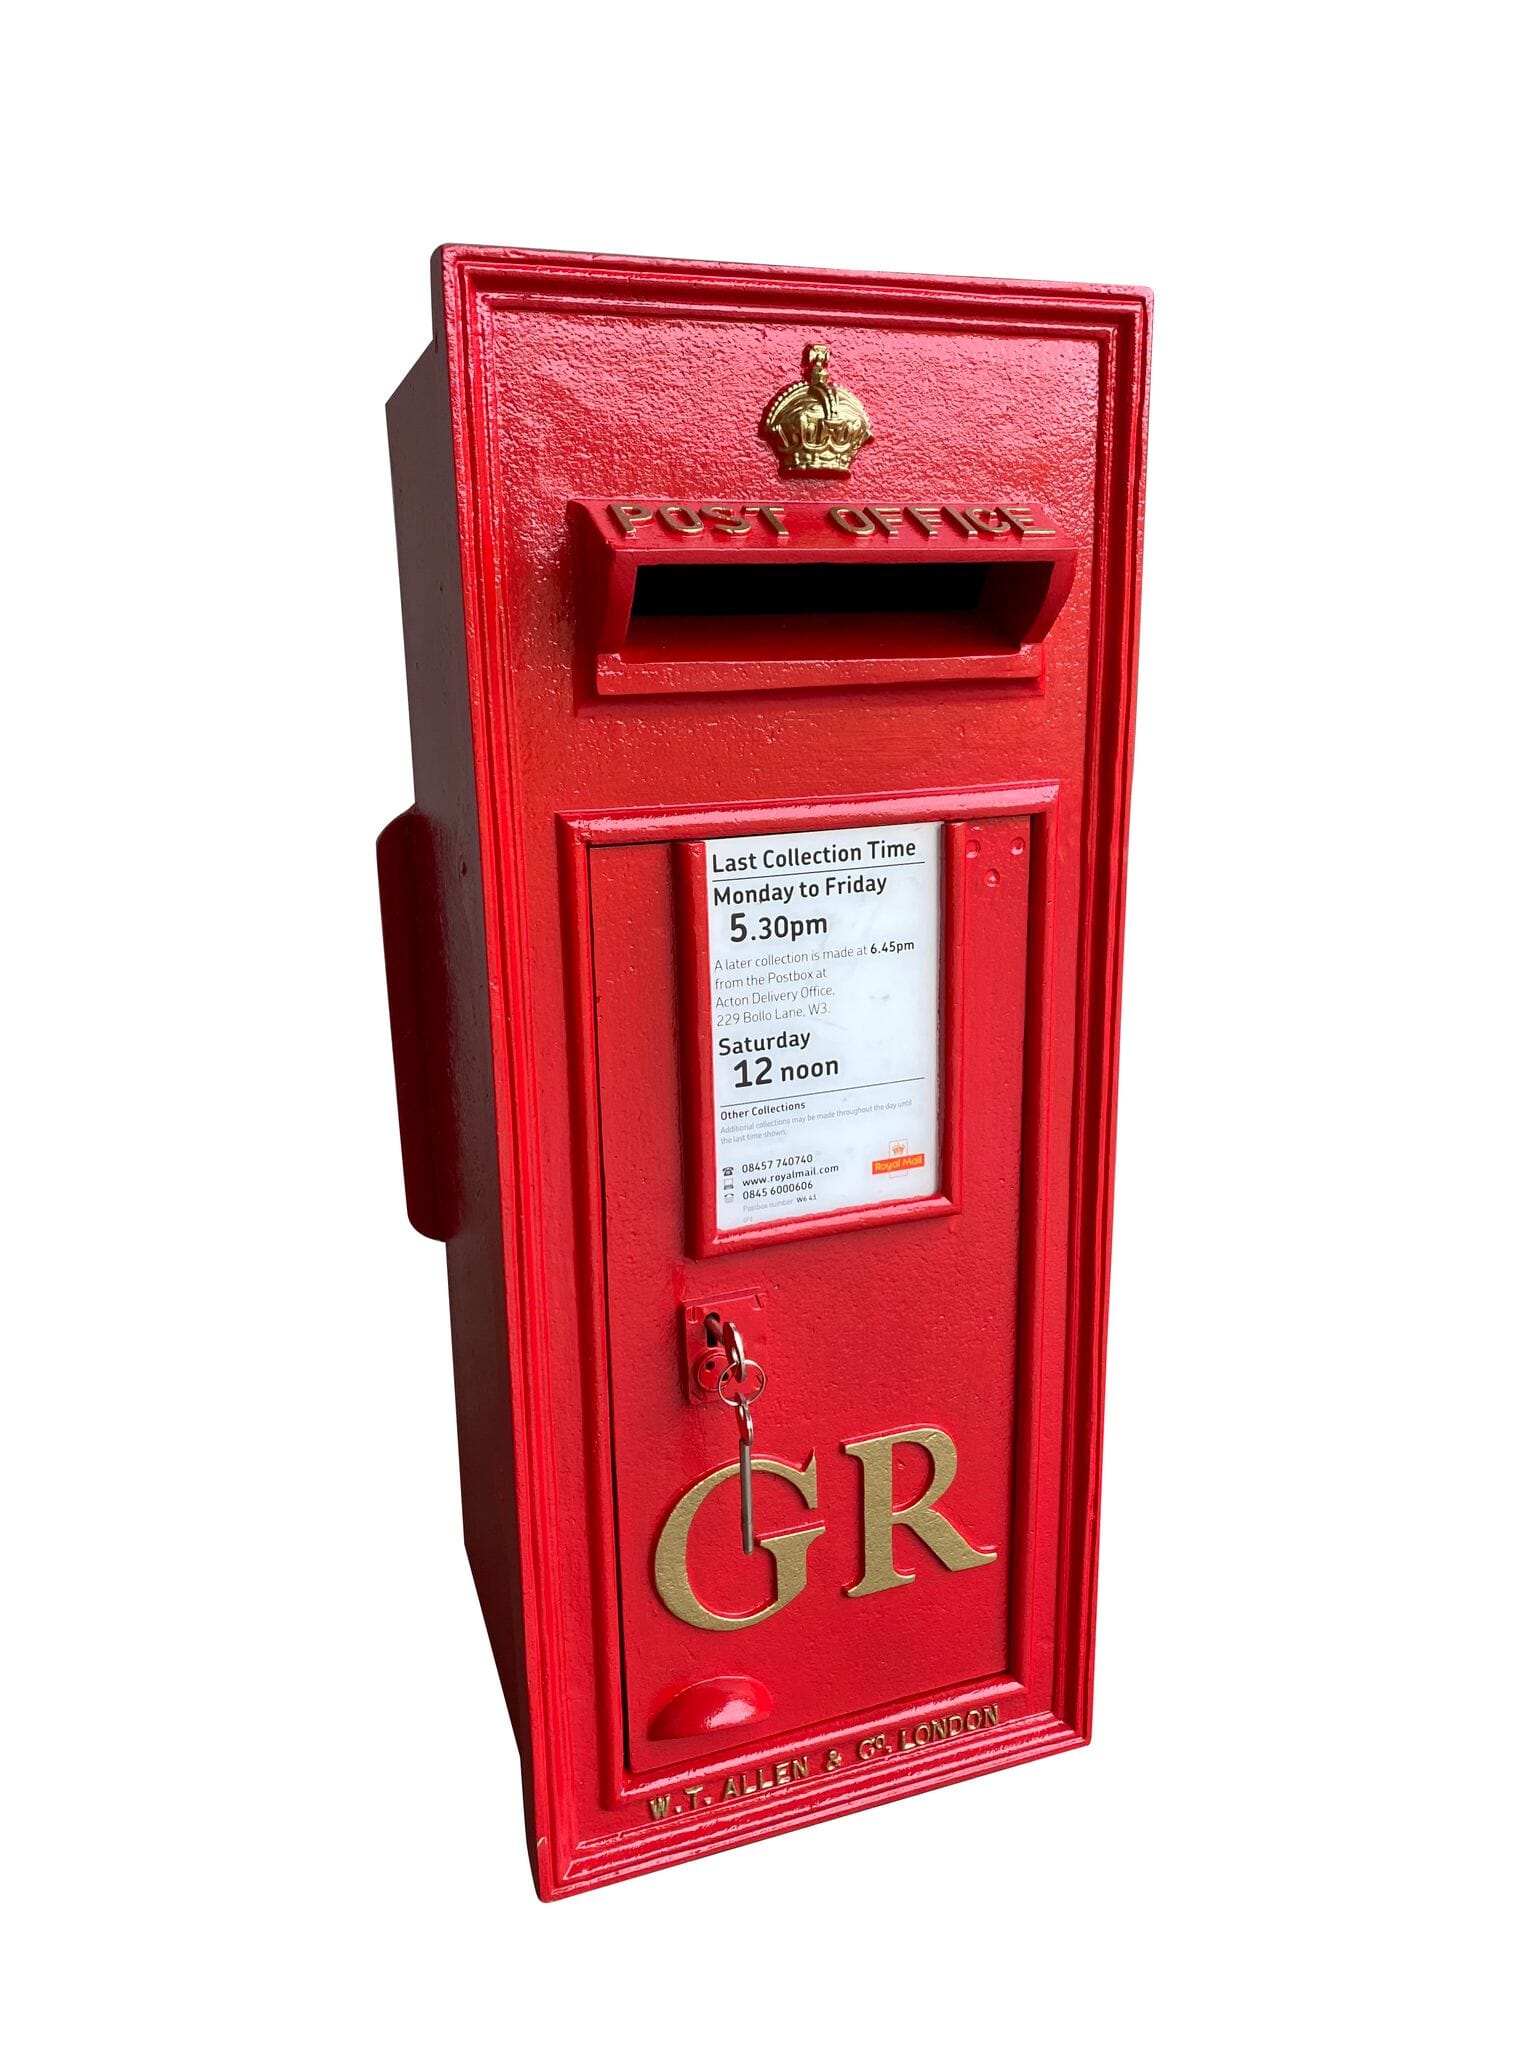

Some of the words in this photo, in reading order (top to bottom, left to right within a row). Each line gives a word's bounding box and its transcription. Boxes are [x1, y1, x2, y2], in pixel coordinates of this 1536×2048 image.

[608, 503, 790, 538] POST
[827, 505, 1057, 538] OFFICE
[712, 852, 757, 873] Last
[763, 845, 861, 868] Collection
[867, 840, 916, 859] Time
[714, 883, 795, 906] Monday
[799, 881, 819, 898] to
[826, 875, 887, 895] Friday
[730, 912, 828, 943] 5.30pm
[714, 959, 723, 972] A
[725, 957, 752, 971] later
[755, 953, 808, 967] collection
[811, 951, 820, 961] is
[822, 948, 854, 960] made
[856, 946, 868, 956] at
[870, 940, 915, 955] 6.45pm
[715, 978, 744, 990] from
[746, 974, 765, 987] the
[768, 970, 814, 984] Postbox
[816, 968, 827, 979] at
[716, 995, 748, 1008] Acton
[752, 988, 798, 1005] Delivery
[717, 1012, 740, 1027] 229
[743, 1008, 772, 1024] Bollo
[808, 1002, 831, 1016] W3.
[719, 1031, 811, 1056] Saturday
[733, 1057, 773, 1088] 12
[780, 1059, 839, 1082] noon
[720, 1110, 749, 1121] Other
[752, 1102, 806, 1116] Collections
[720, 1123, 754, 1134] Additional
[755, 1118, 791, 1129] collections
[792, 1115, 806, 1123] may
[807, 1113, 816, 1121] be
[816, 1111, 835, 1120] made
[836, 1105, 873, 1117] throughout
[873, 1103, 885, 1112] the
[885, 1102, 897, 1110] day
[897, 1099, 912, 1108] until
[720, 1135, 732, 1144] the
[733, 1133, 746, 1142] last
[746, 1131, 762, 1141] time
[741, 1160, 774, 1174] 08457
[776, 1153, 813, 1168] 740740
[742, 1164, 839, 1187] www.royalmail.com
[874, 1159, 900, 1172] Royal
[902, 1155, 922, 1166] Mail
[742, 1188, 768, 1200] 0845
[770, 1180, 814, 1196] 6000606
[654, 1426, 998, 1631] GR
[723, 1756, 808, 1799] ALLEN
[826, 1750, 842, 1772] &
[898, 1703, 998, 1750] LONDON
